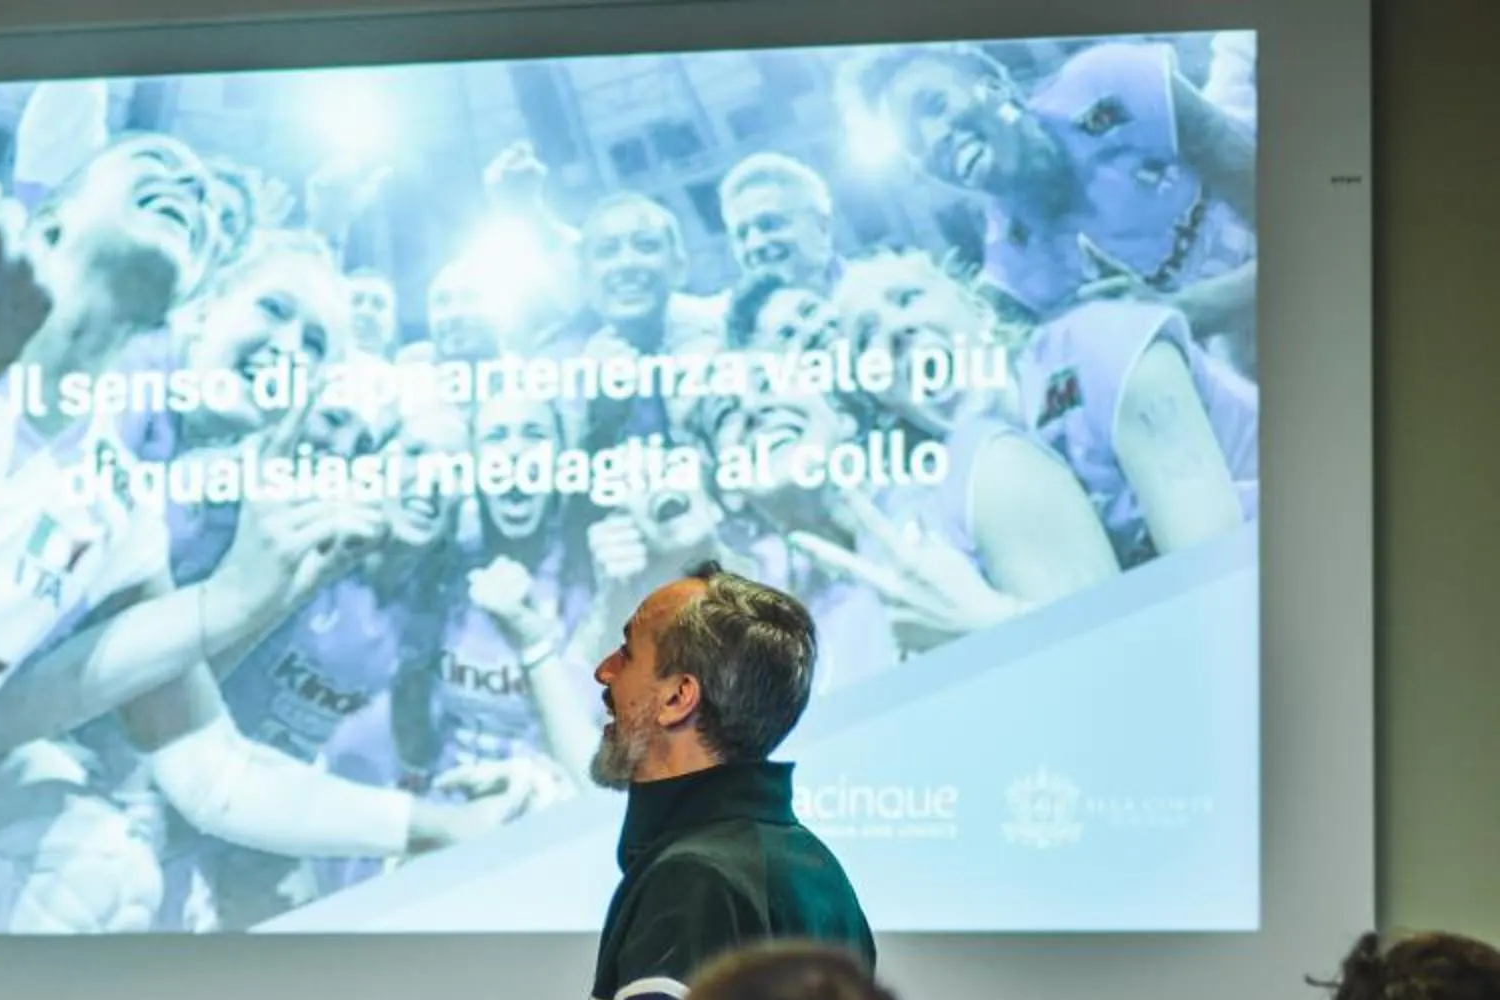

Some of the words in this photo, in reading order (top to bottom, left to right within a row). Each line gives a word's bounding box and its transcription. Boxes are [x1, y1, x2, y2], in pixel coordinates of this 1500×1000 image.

[7, 360, 48, 416] Il
[57, 365, 242, 417] senso
[253, 350, 310, 411] di
[320, 350, 746, 416] appartenenza
[762, 336, 894, 394] vale
[910, 330, 1008, 404] più
[65, 440, 116, 504] di
[127, 440, 401, 513] qualsiasi
[416, 434, 700, 506] medaglia
[716, 432, 777, 490] al
[789, 429, 951, 489] collo
